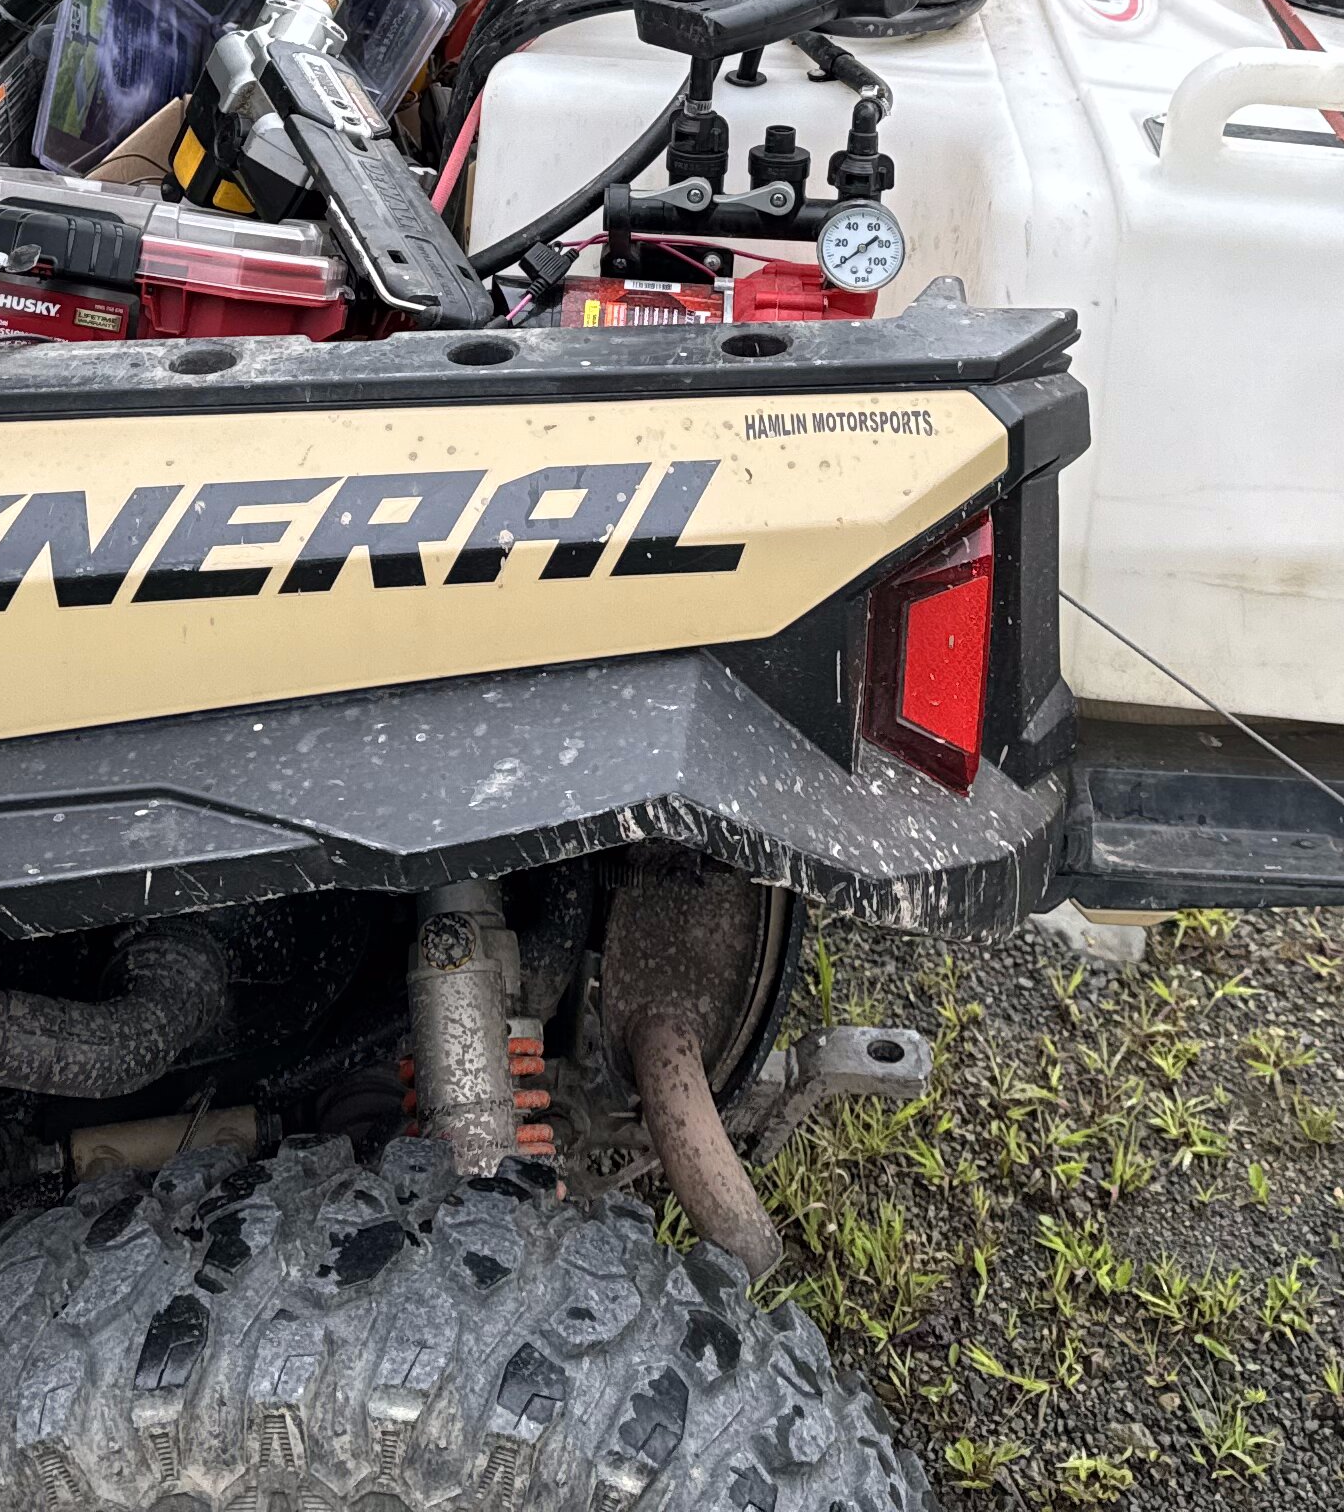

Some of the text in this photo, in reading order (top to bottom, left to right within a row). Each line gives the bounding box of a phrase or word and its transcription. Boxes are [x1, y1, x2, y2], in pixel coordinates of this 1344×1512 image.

[845, 221, 881, 232] 40 60
[834, 238, 849, 247] 20
[877, 239, 891, 248] 80
[867, 257, 887, 266] 100
[854, 276, 869, 284] psi
[78, 311, 118, 324] LIFETIME
[77, 318, 117, 329] WARRANTY
[744, 410, 933, 441] HAMLIN MOTORSPORTS
